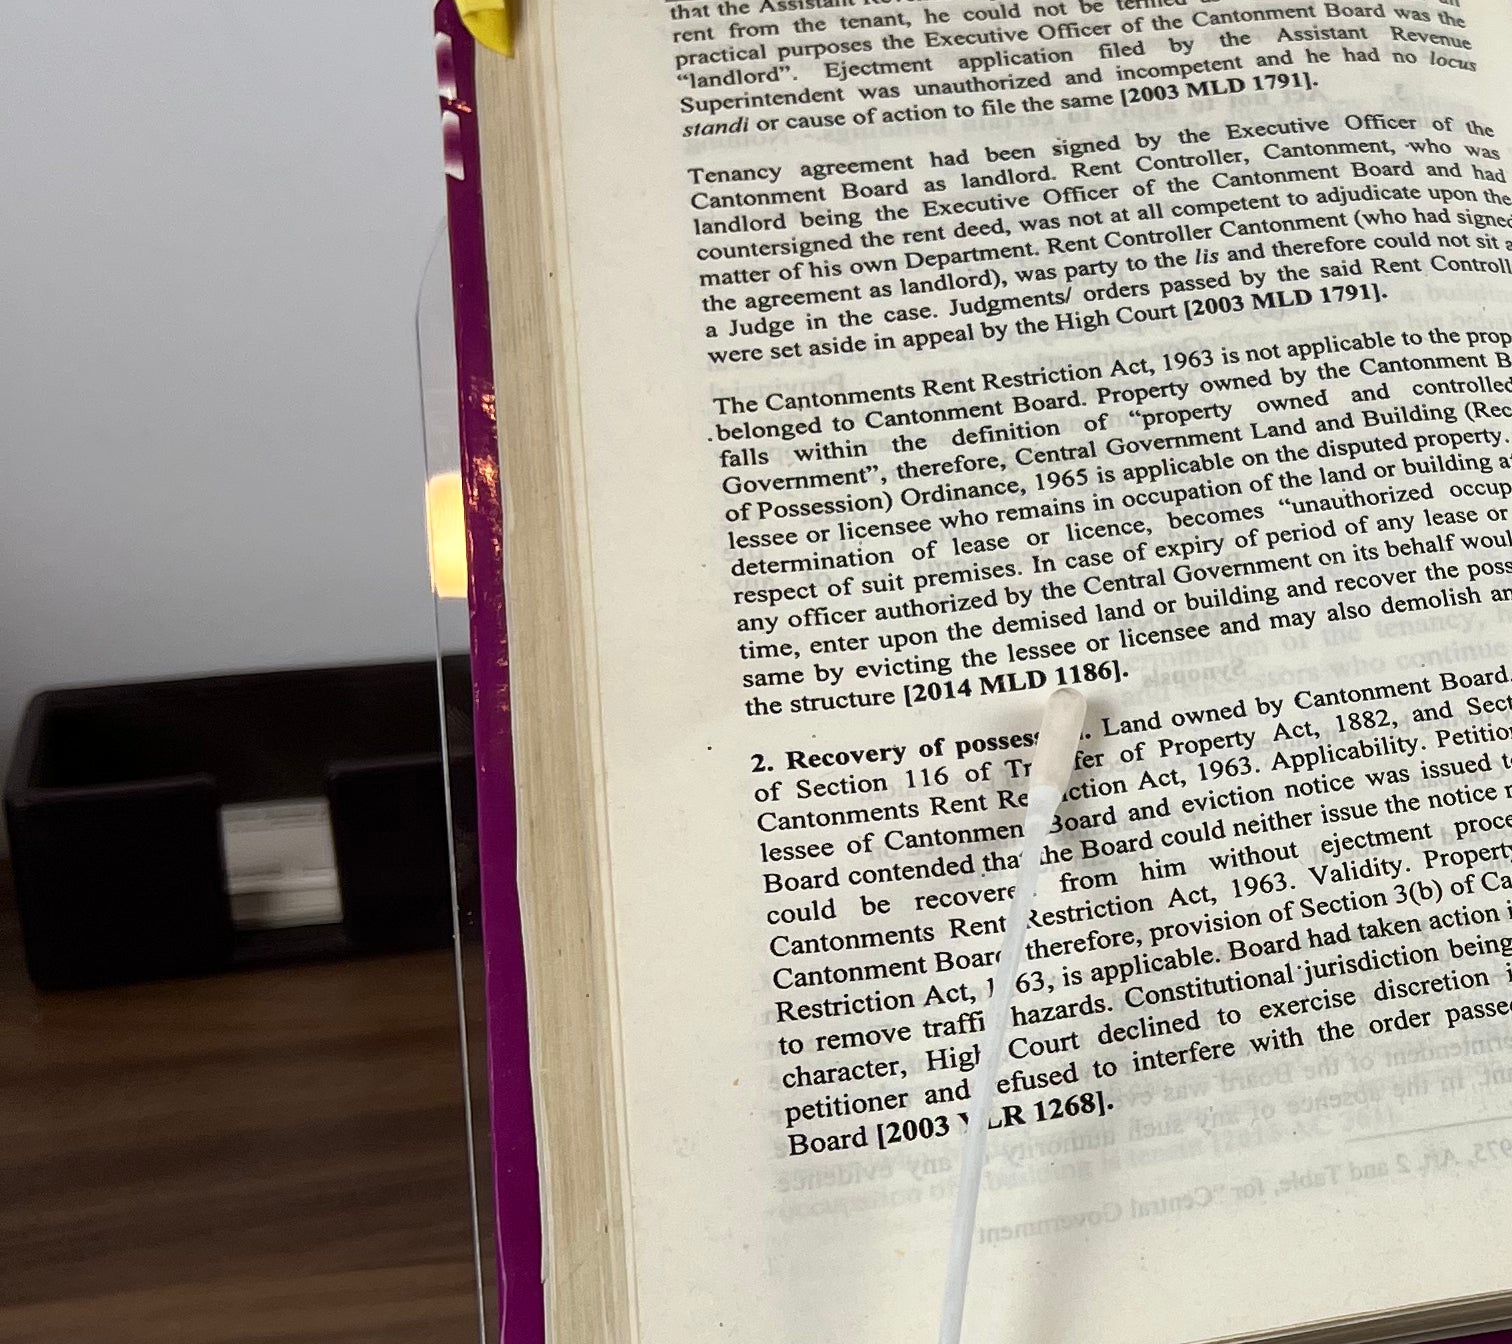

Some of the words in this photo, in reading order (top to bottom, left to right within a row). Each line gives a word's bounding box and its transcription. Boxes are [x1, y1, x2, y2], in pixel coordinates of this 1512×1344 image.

[670, 4, 710, 20] that
[717, 1, 750, 16] the
[683, 116, 749, 137] standi
[757, 119, 779, 131] or
[786, 114, 845, 129] cause
[853, 107, 877, 125] of
[882, 105, 947, 123] action
[953, 105, 974, 118] to
[982, 99, 1016, 116] file
[1022, 96, 1054, 112] the
[1061, 94, 1114, 109] same
[1120, 84, 1179, 107] [2003
[1185, 78, 1245, 98] MLD
[1253, 72, 1318, 91] 1791].
[687, 167, 781, 184] Tenancy
[801, 156, 914, 180] agreement
[929, 149, 969, 167] had
[985, 147, 1035, 162] been
[1052, 135, 1121, 158] signed
[1135, 133, 1161, 151] by
[1178, 128, 1211, 144] the
[1225, 118, 1330, 140] Executive
[1345, 114, 1416, 130] Officer
[1432, 117, 1454, 132] of
[1465, 120, 1494, 137] the
[713, 396, 758, 415] The
[766, 385, 916, 411] Cantonments
[921, 377, 976, 397] Rent
[981, 364, 1103, 391] Restriction
[1110, 359, 1155, 377] Act,
[1163, 349, 1213, 371] 1963
[1221, 347, 1240, 364] is
[1245, 344, 1281, 362] not
[1287, 331, 1396, 361] applicable
[1401, 332, 1422, 345] to
[1428, 328, 1460, 344] the
[745, 697, 782, 716] the
[790, 692, 895, 713] structure
[904, 679, 972, 707] [2014
[978, 670, 1047, 695] MLD
[1055, 660, 1128, 684] 1186].
[751, 754, 773, 772] 2.
[785, 745, 906, 770] Recovery
[919, 738, 945, 757] of
[955, 728, 1091, 759] posses.
[1101, 710, 1162, 737] Land
[1172, 699, 1248, 726] owned
[1255, 697, 1283, 718] by
[1294, 678, 1432, 709] Cantonment
[770, 925, 934, 957] Cantonments
[948, 916, 1006, 939] Rent
[1168, 886, 1217, 908] Act,
[1232, 872, 1295, 898] 1963.
[1308, 857, 1410, 885] Validity.
[788, 1125, 868, 1156] Board
[877, 1113, 951, 1150] [2003
[1034, 1091, 1113, 1122] 1268].
